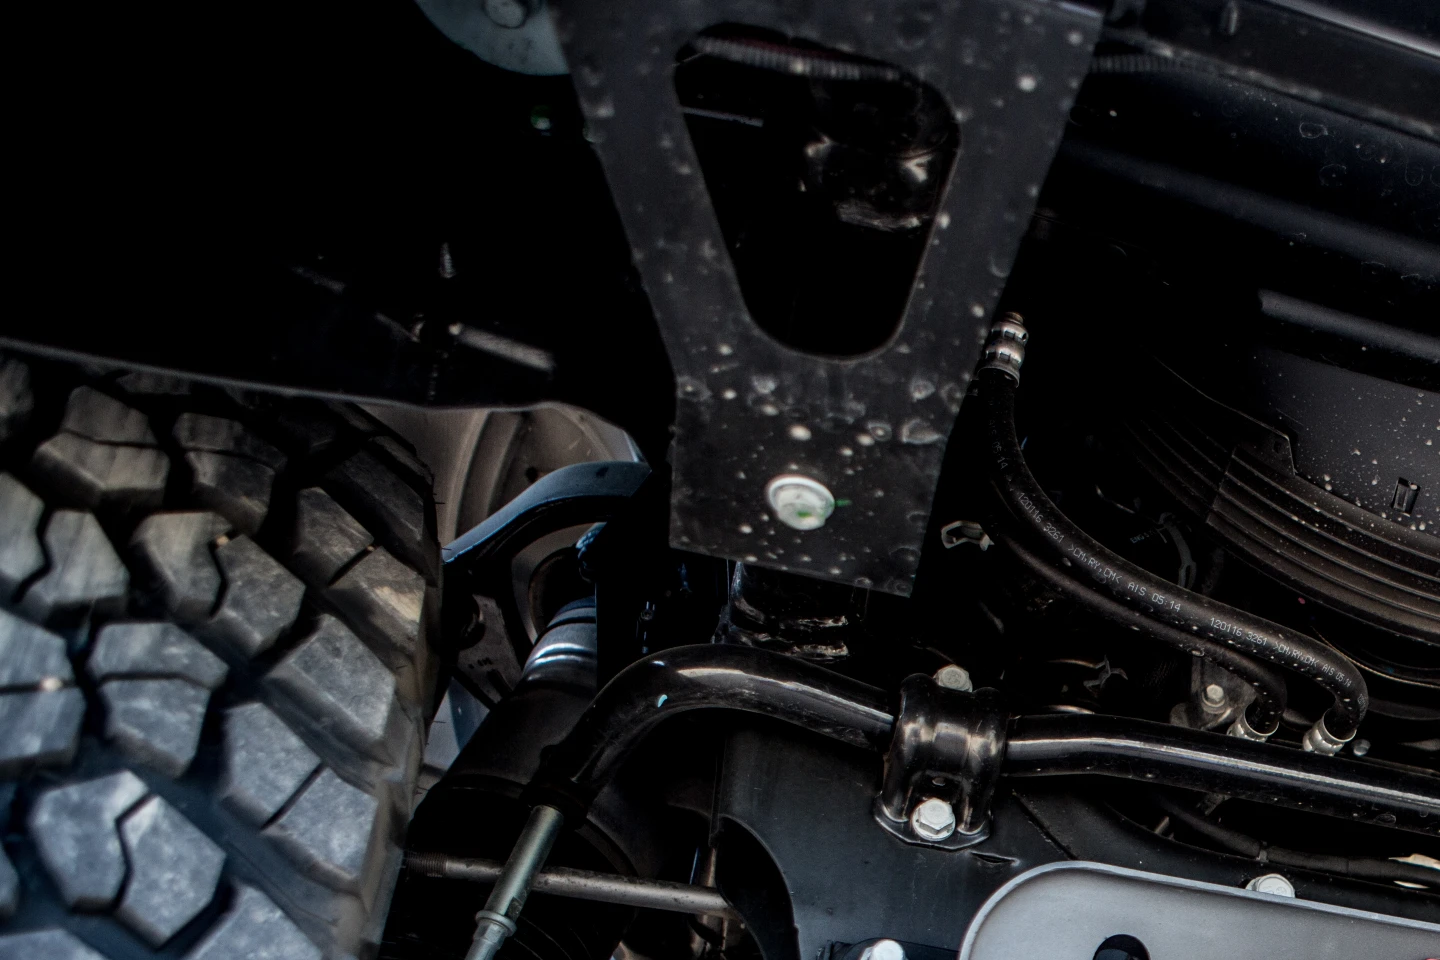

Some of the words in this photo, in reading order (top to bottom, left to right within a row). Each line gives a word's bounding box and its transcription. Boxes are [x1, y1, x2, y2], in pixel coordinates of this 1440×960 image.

[1017, 491, 1044, 523] 120116
[1043, 522, 1065, 543] 3261
[1127, 581, 1147, 597] AIS
[1151, 592, 1181, 612] 05:14
[1209, 617, 1243, 637] 120116
[1246, 631, 1268, 646] 3261
